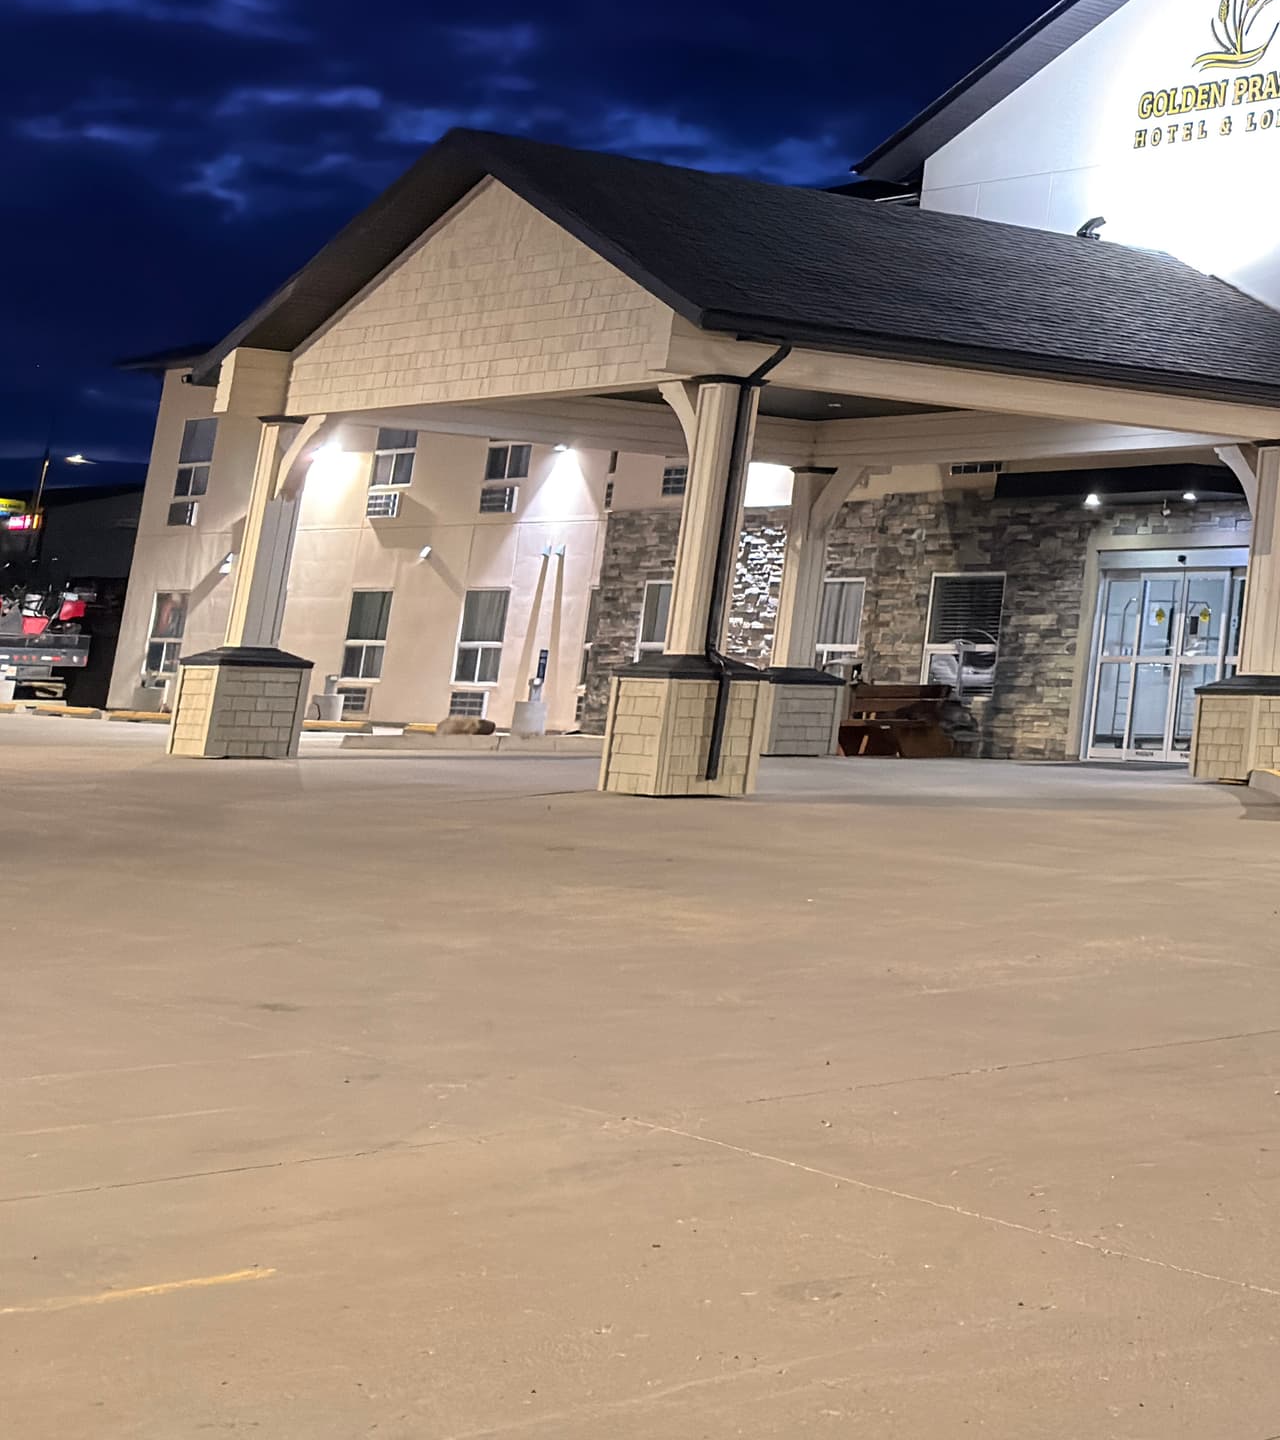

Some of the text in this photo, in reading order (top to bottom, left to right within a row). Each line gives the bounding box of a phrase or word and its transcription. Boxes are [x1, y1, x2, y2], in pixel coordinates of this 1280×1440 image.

[1138, 79, 1229, 119] GOLDEN
[1133, 120, 1207, 148] HOTEL
[1219, 116, 1232, 135] &
